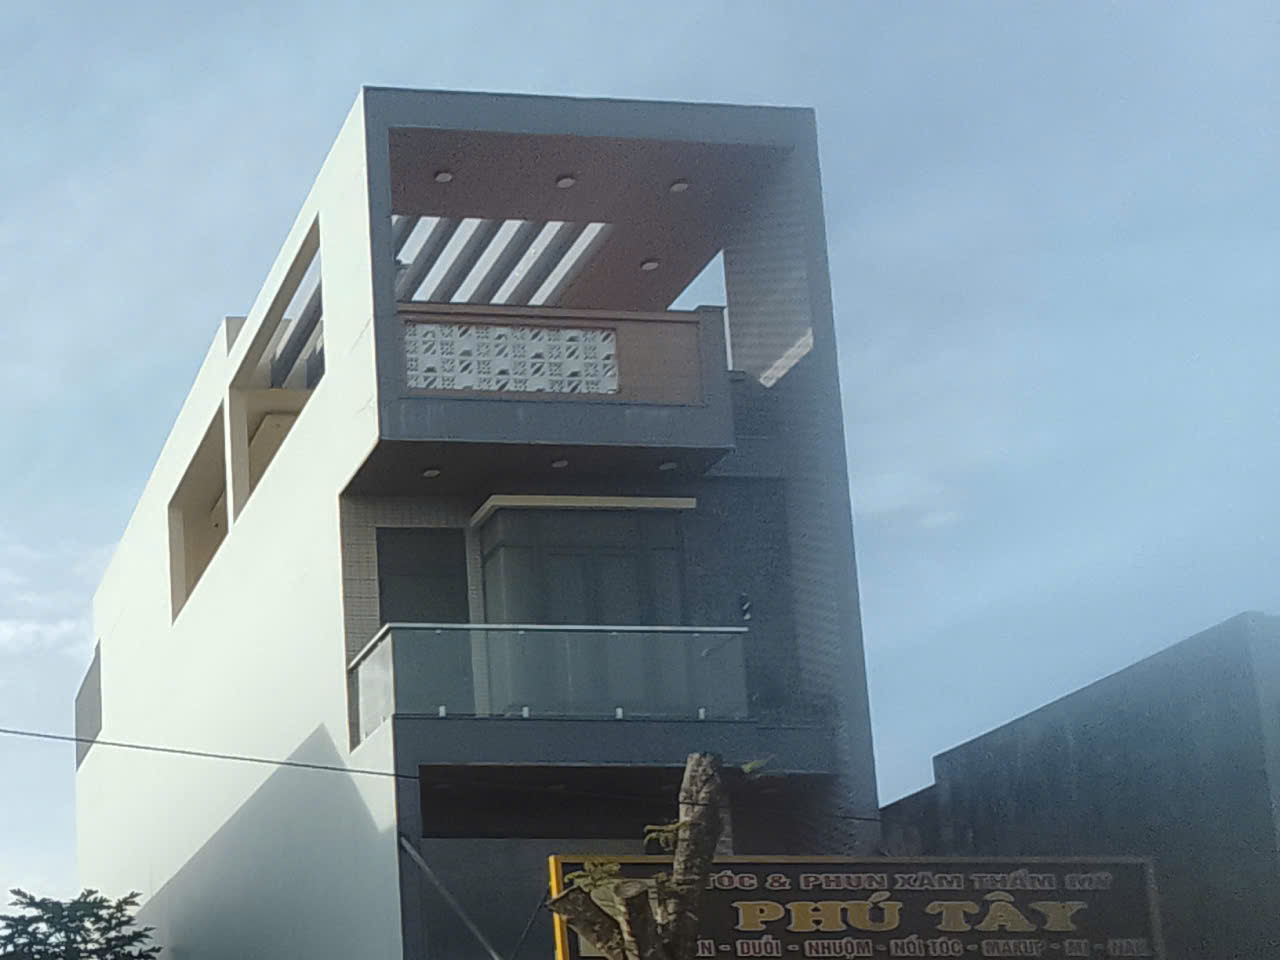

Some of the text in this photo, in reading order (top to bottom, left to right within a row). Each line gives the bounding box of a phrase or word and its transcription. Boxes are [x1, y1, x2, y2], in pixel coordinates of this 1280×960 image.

[766, 873, 791, 890] &
[800, 873, 888, 890] PHUN
[731, 890, 1088, 932] PHÚ TÂY
[804, 937, 872, 960] NHUỘM
[927, 936, 964, 957] TÓC
